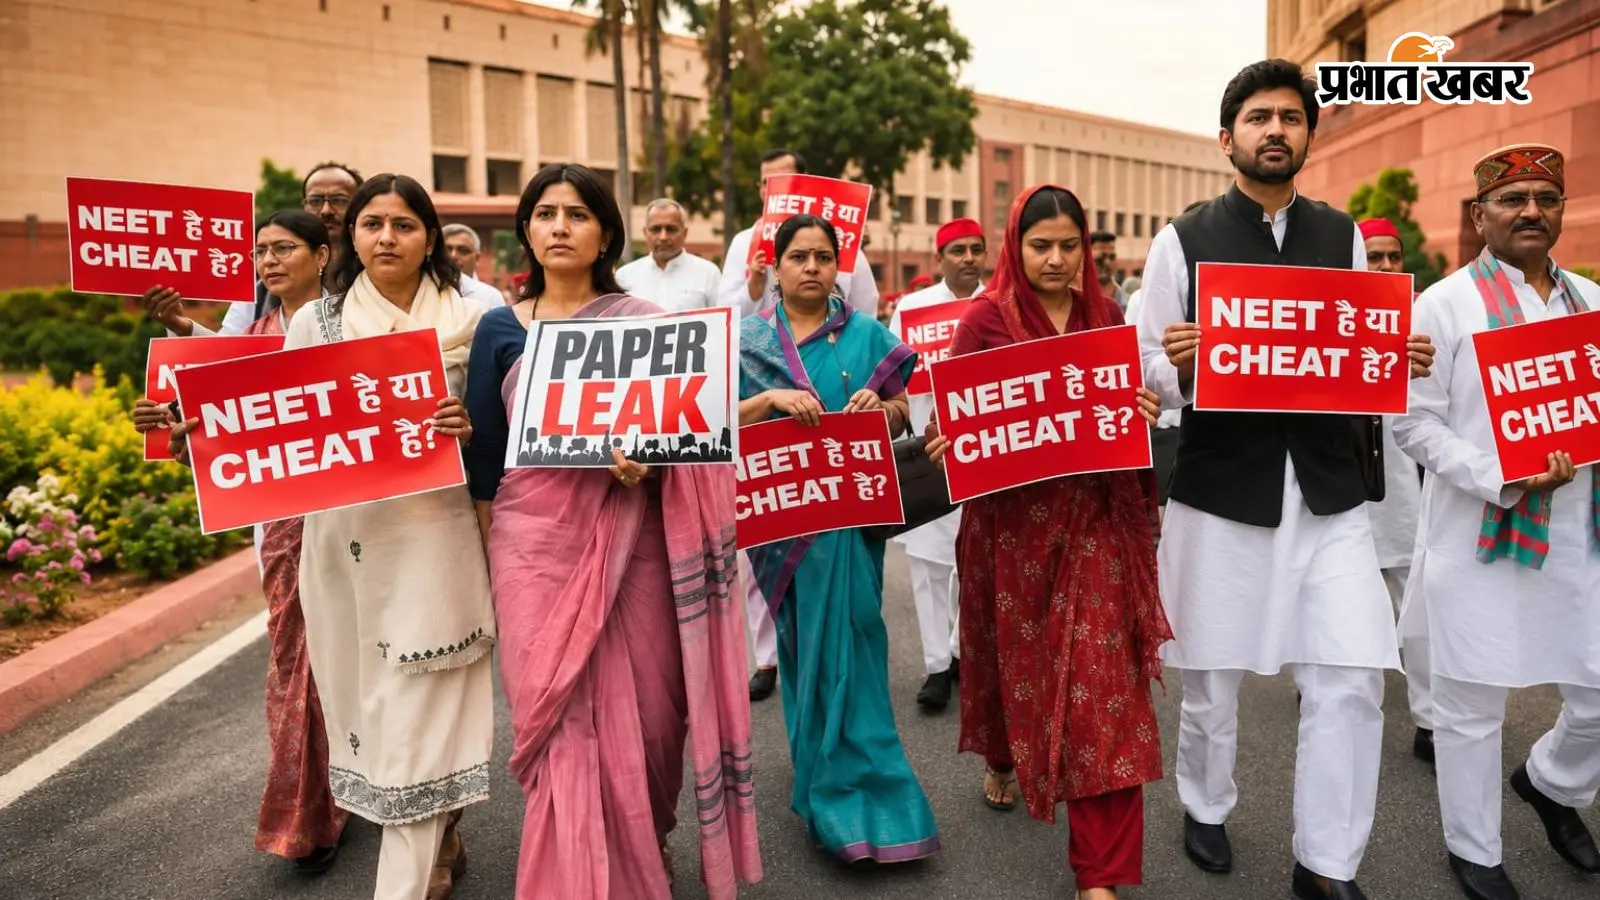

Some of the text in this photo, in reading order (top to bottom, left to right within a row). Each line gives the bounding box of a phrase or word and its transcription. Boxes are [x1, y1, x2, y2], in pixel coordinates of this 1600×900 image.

[77, 205, 243, 241] NEET है या
[766, 193, 861, 224] NEET है या
[79, 241, 244, 278] CHEAT है?
[1211, 296, 1401, 337] NEET है या
[550, 320, 707, 379] PAPER
[1209, 343, 1399, 384] CHEAT है?
[1487, 349, 1577, 397] NEET
[200, 370, 435, 438] NEET है या
[540, 375, 710, 436] LEAK
[946, 363, 1131, 421] NEET है या
[210, 418, 436, 489] CHEAT है?
[821, 437, 845, 467] है
[850, 440, 884, 461] या
[952, 404, 1134, 464] CHEAT है?
[735, 471, 887, 521] CHEAT है?
